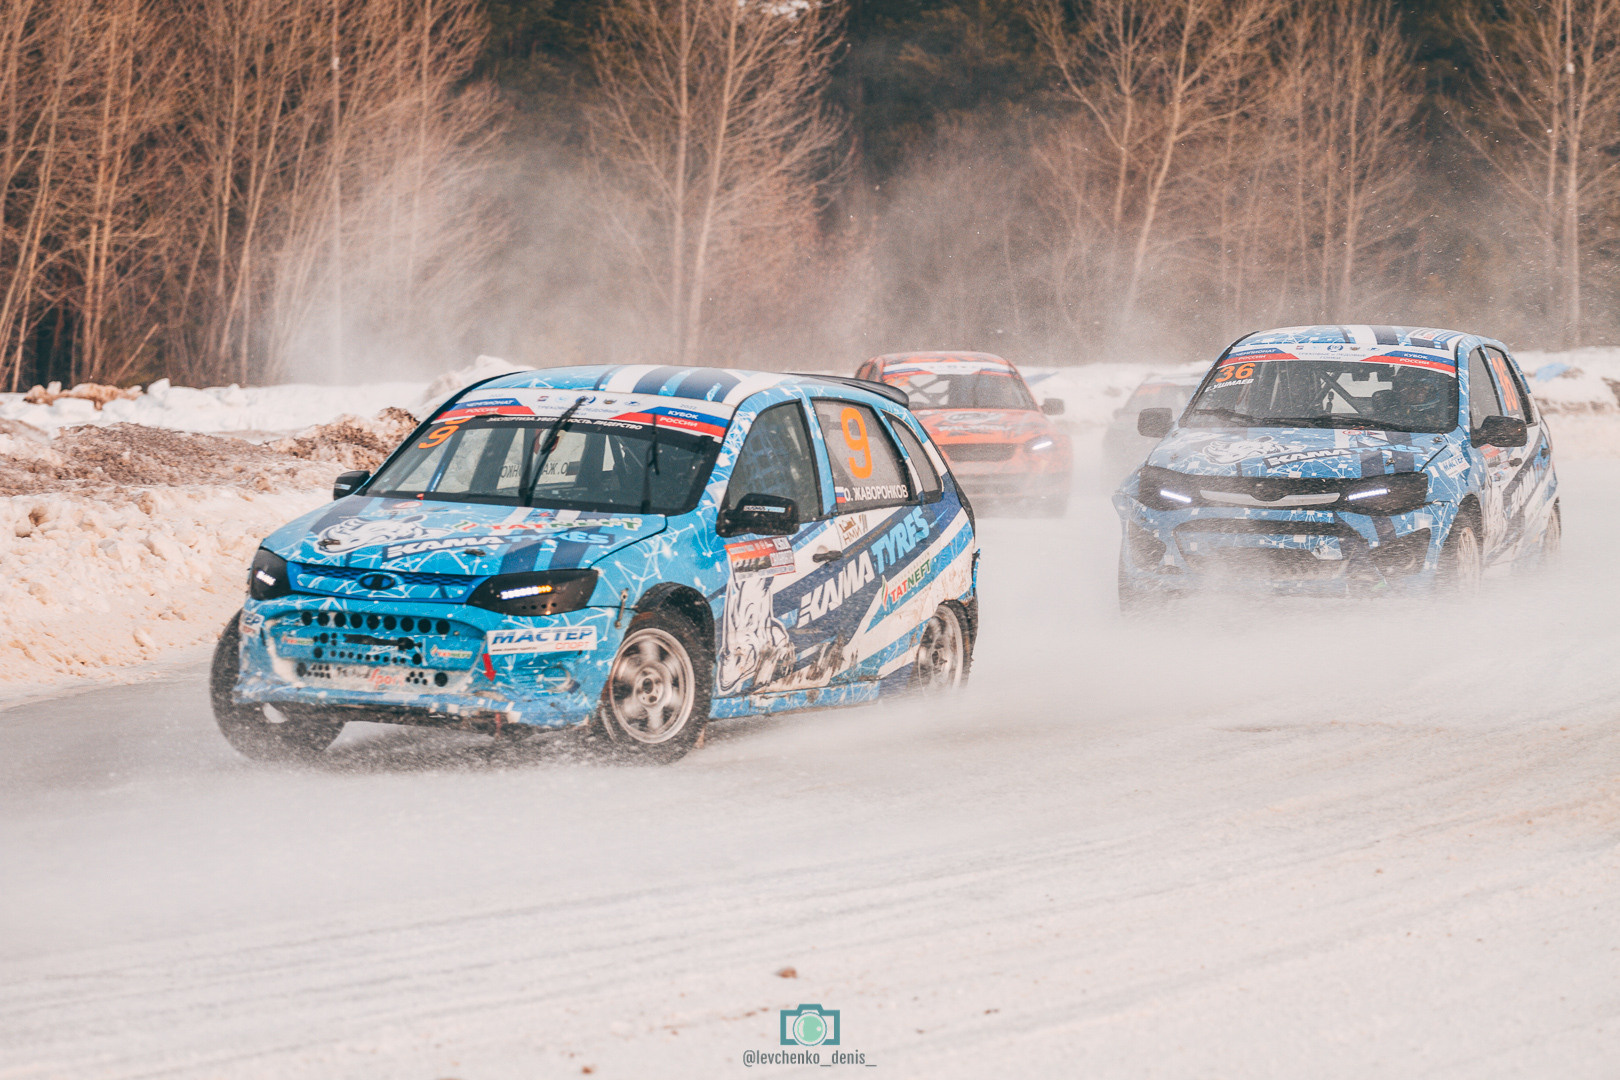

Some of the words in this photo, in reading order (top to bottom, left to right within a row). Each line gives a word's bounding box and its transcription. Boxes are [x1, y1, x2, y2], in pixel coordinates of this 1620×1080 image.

[1215, 362, 1256, 383] 36
[659, 416, 698, 427] РОССИИ
[667, 410, 699, 420] КУБОК
[418, 425, 459, 449] 9
[840, 407, 873, 479] 9
[1268, 449, 1352, 466] KAMA
[855, 484, 909, 500] ЖАВОРОНКОВ
[388, 536, 505, 557] KAMA
[797, 551, 875, 628] KAMA
[871, 506, 930, 574] TYRES
[890, 559, 930, 603] TATNEFT
[492, 628, 594, 645] МАСТЕР
[556, 641, 590, 650] СПОРТ
